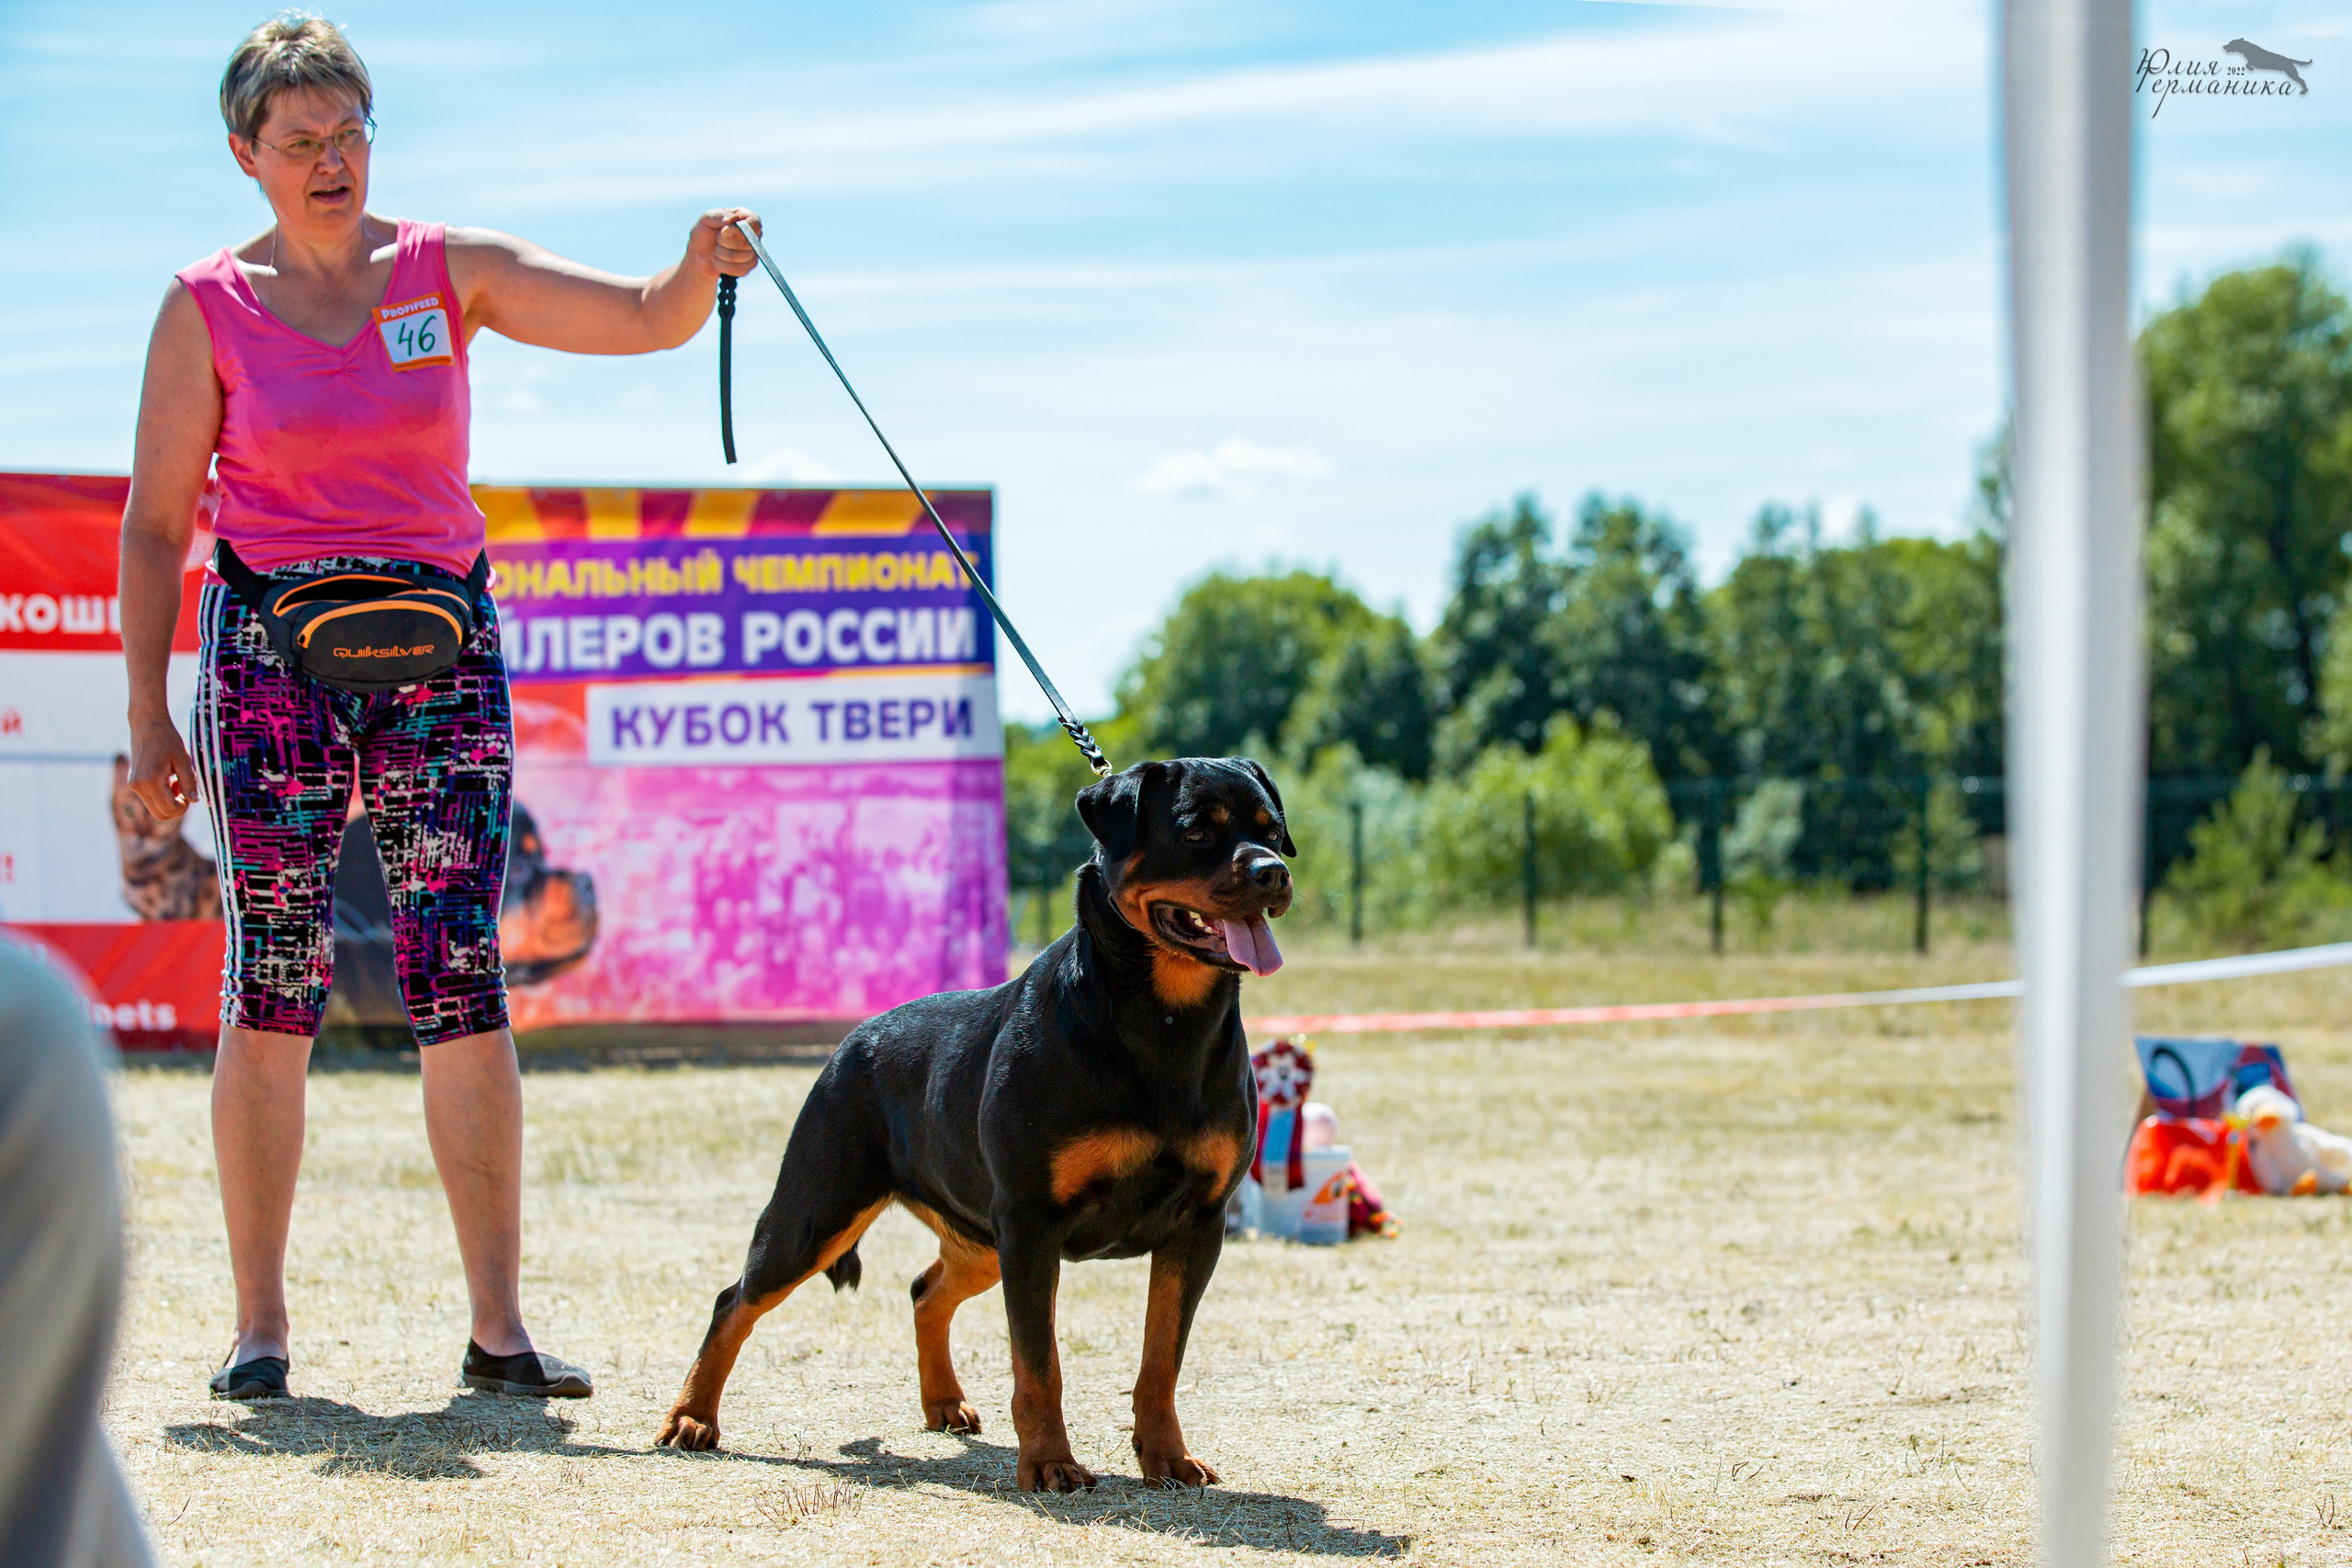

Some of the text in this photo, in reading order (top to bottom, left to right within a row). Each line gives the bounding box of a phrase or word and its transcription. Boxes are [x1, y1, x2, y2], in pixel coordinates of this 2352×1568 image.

[397, 314, 437, 357] 46
[741, 606, 977, 668] РОССИИ
[610, 695, 974, 747] КУБОК ТВЕРИ
